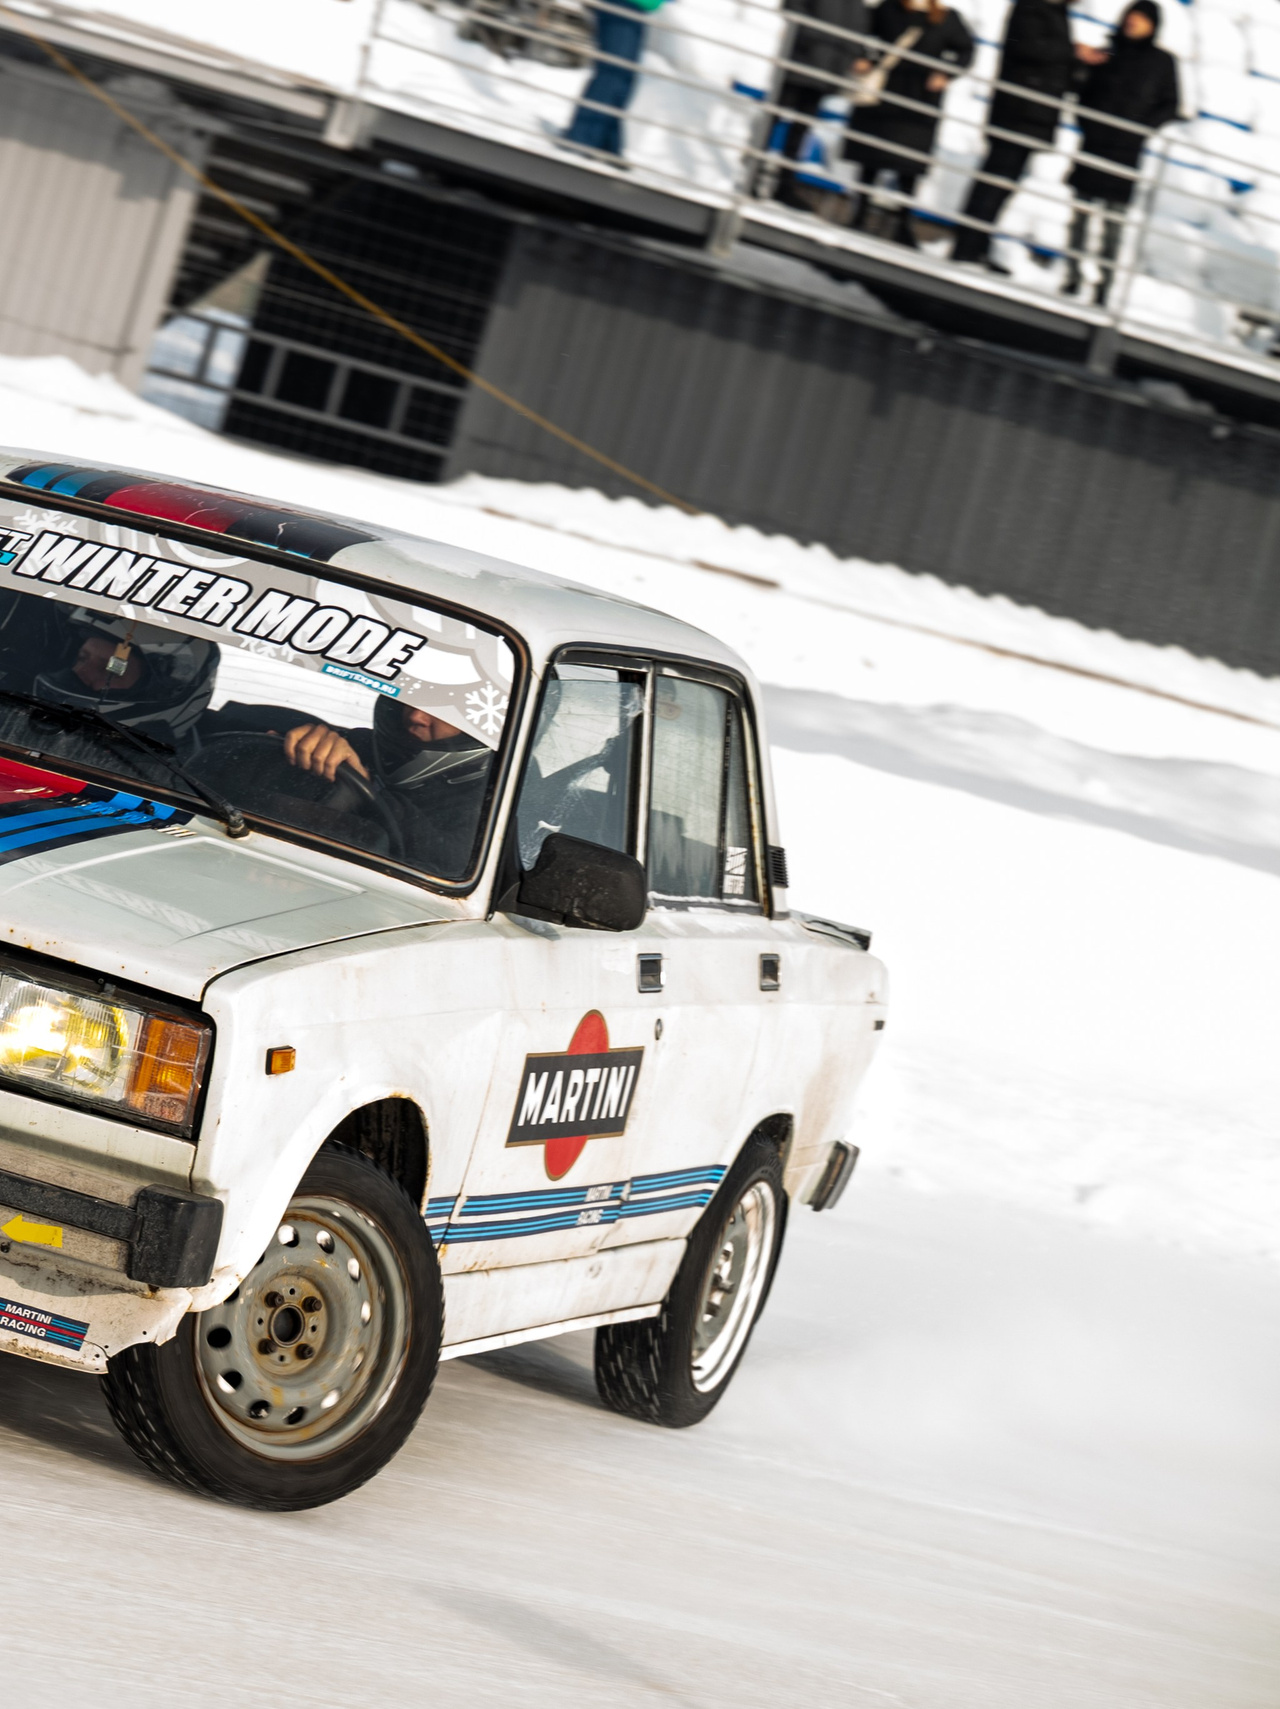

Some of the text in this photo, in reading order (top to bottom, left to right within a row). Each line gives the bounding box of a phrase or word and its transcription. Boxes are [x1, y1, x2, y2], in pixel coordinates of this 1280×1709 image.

[14, 531, 427, 680] WINTER MODE
[324, 665, 397, 695] DRIFTEXPO.RU
[517, 1065, 636, 1126] MARTINI
[0, 1315, 48, 1338] RACING
[5, 1303, 53, 1325] MARTINI
